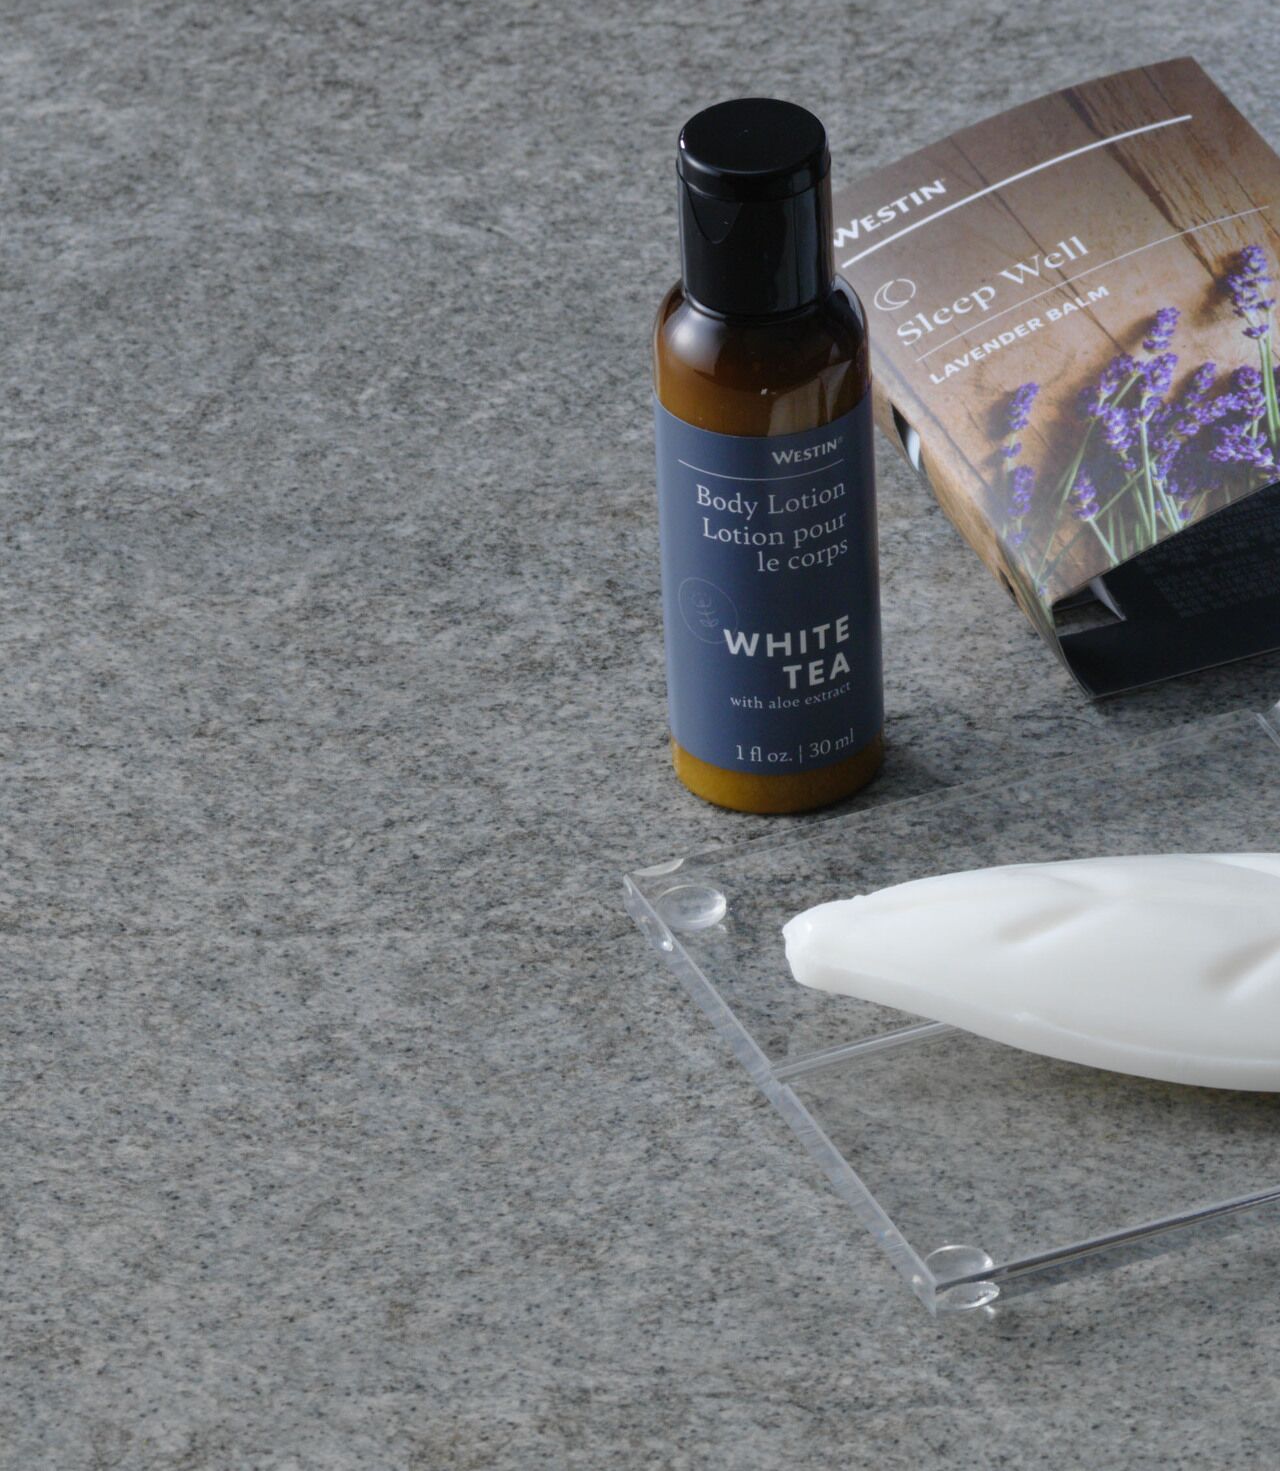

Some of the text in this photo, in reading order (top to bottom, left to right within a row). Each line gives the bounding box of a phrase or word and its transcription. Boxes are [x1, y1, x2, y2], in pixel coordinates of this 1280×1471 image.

[833, 179, 946, 248] WESTIN
[897, 236, 1089, 347] Sleep Well
[930, 286, 1110, 384] LAVENDER BALM
[696, 482, 845, 520] Body Lotion
[703, 512, 847, 549] Lotion pour
[757, 538, 848, 572] le corps
[723, 614, 849, 657] WHITE
[783, 652, 850, 690] TEA
[730, 682, 851, 710] with aloe extract
[736, 744, 744, 761] 1
[750, 745, 762, 762] fl
[767, 751, 793, 763] oz.
[809, 739, 831, 758] 30
[835, 727, 854, 751] ml
